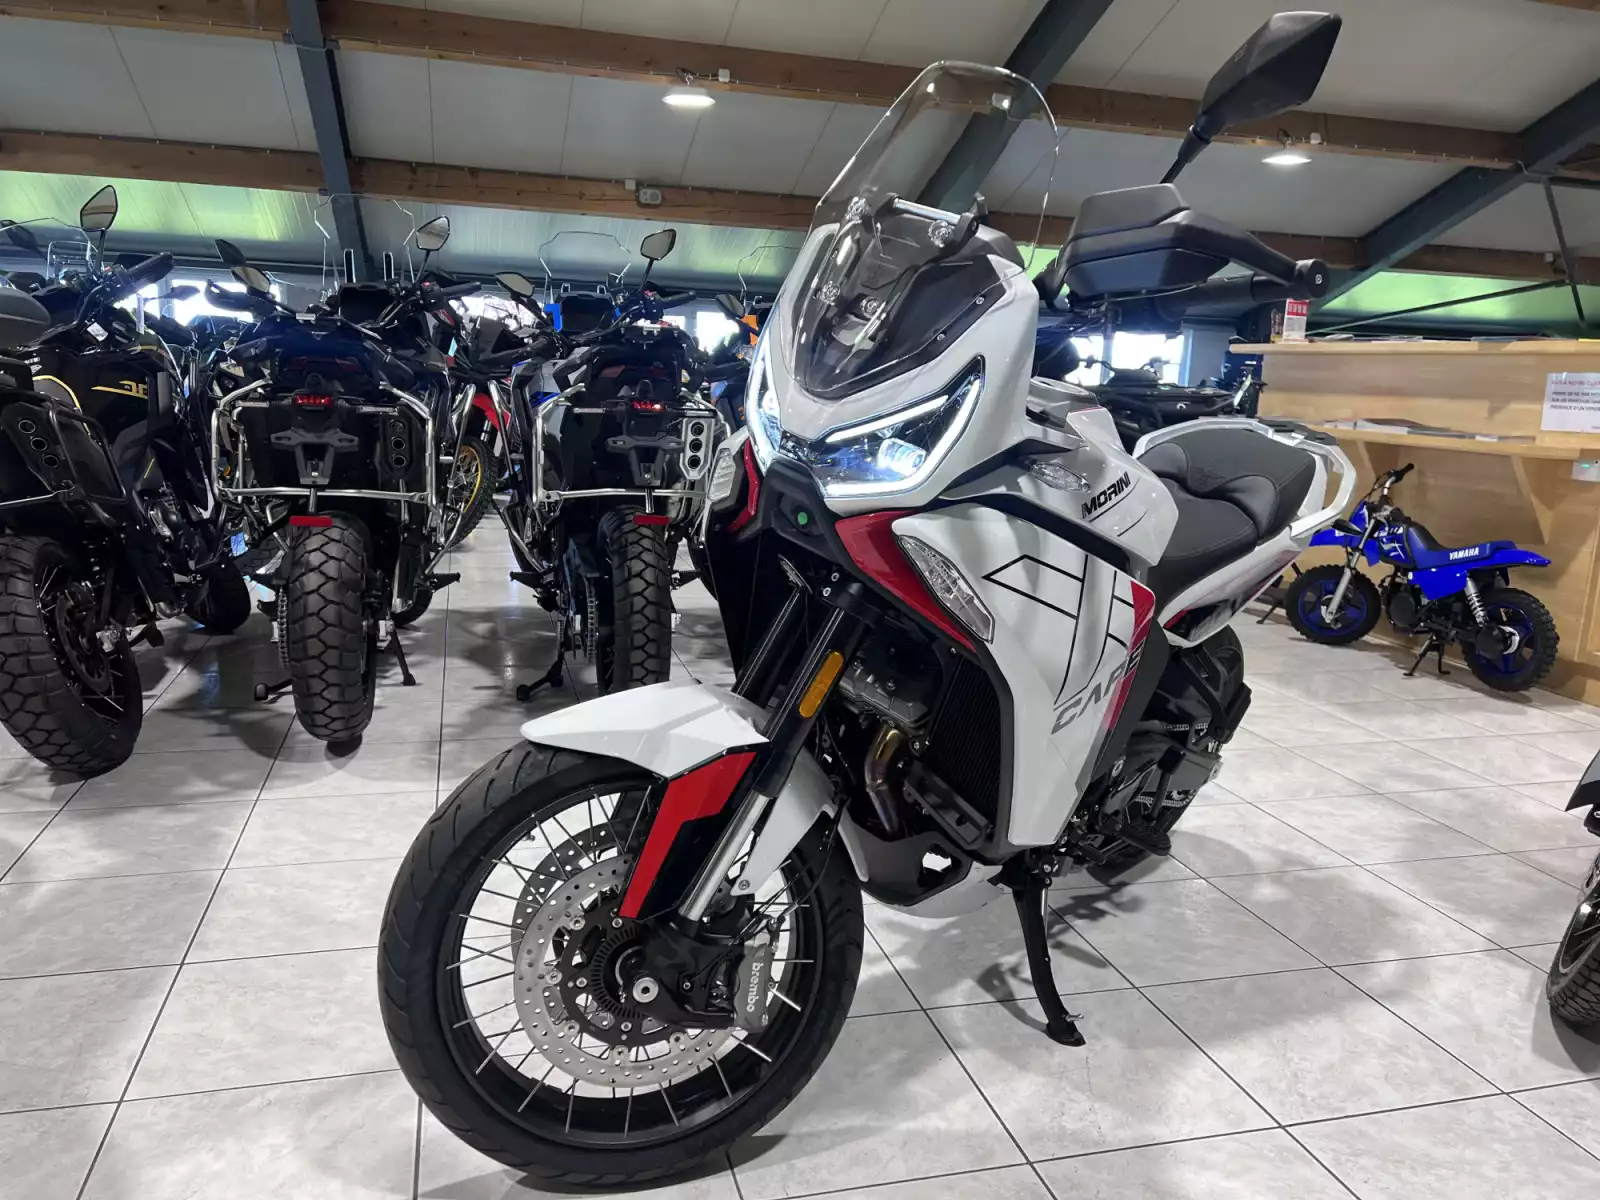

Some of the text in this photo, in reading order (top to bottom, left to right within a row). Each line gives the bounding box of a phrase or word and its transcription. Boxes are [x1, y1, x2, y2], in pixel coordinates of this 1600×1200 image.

[1081, 471, 1131, 519] MORINI
[1449, 547, 1480, 560] YAMAHA
[1050, 637, 1147, 735] CAPE
[746, 962, 764, 1013] brembo
